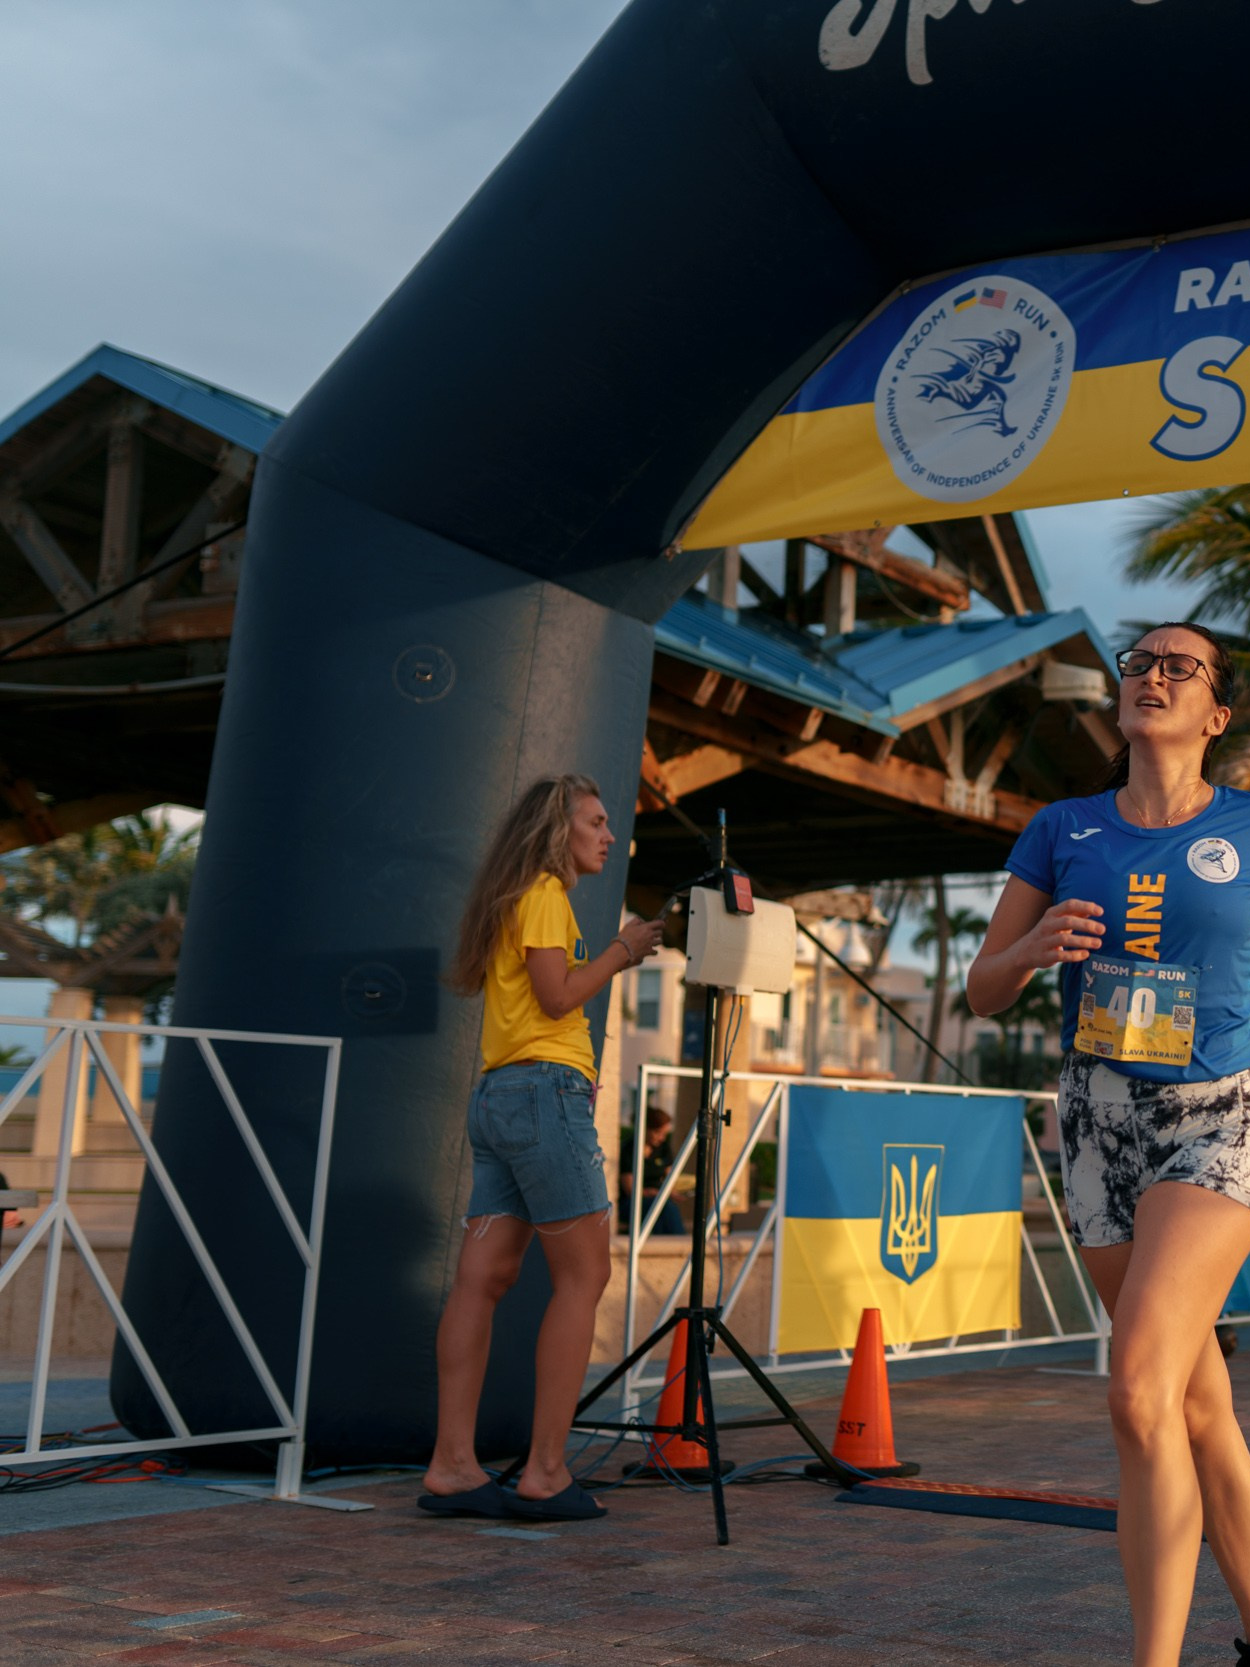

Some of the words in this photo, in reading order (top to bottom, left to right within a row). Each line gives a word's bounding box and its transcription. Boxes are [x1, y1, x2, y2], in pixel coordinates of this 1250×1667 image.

[895, 308, 947, 371] RAZOM
[1013, 298, 1050, 332] RUN
[911, 463, 926, 476] OF
[926, 457, 1012, 488] INDEPENDENCE
[1012, 441, 1027, 460] OF
[1026, 386, 1058, 441] UKRAINE
[1124, 873, 1167, 962] AINE
[1092, 961, 1130, 977] RAZOM
[1157, 970, 1186, 982] RUN
[1106, 985, 1157, 1029] 40
[1119, 1049, 1145, 1057] SLAVA
[838, 1420, 866, 1437] SST
